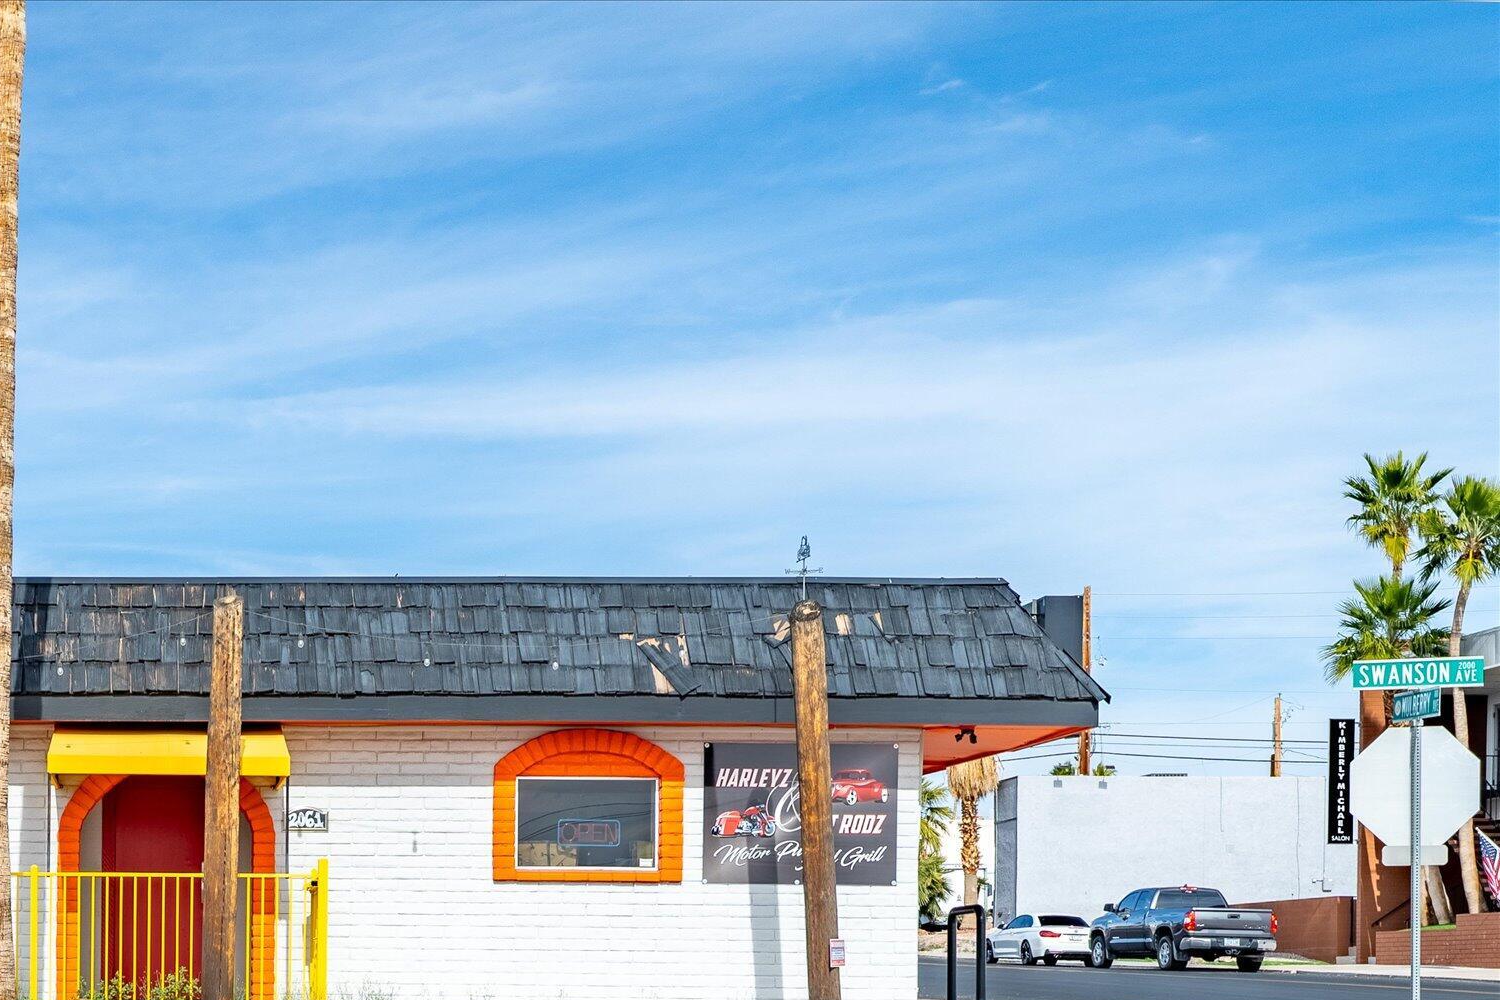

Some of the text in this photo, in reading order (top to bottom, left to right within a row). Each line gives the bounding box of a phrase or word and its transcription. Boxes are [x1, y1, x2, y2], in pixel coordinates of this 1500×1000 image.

[1359, 662, 1450, 686] SWANSON
[1455, 669, 1478, 683] AVE
[1458, 661, 1476, 670] 2000
[716, 767, 793, 788] HARLEYZ
[1336, 721, 1346, 834] KIMBERLY MICHAEL
[288, 810, 325, 828] 2061
[839, 814, 887, 834] RODZ
[561, 822, 618, 843] OPEN
[713, 844, 771, 866] Motor
[840, 845, 888, 870] Grill
